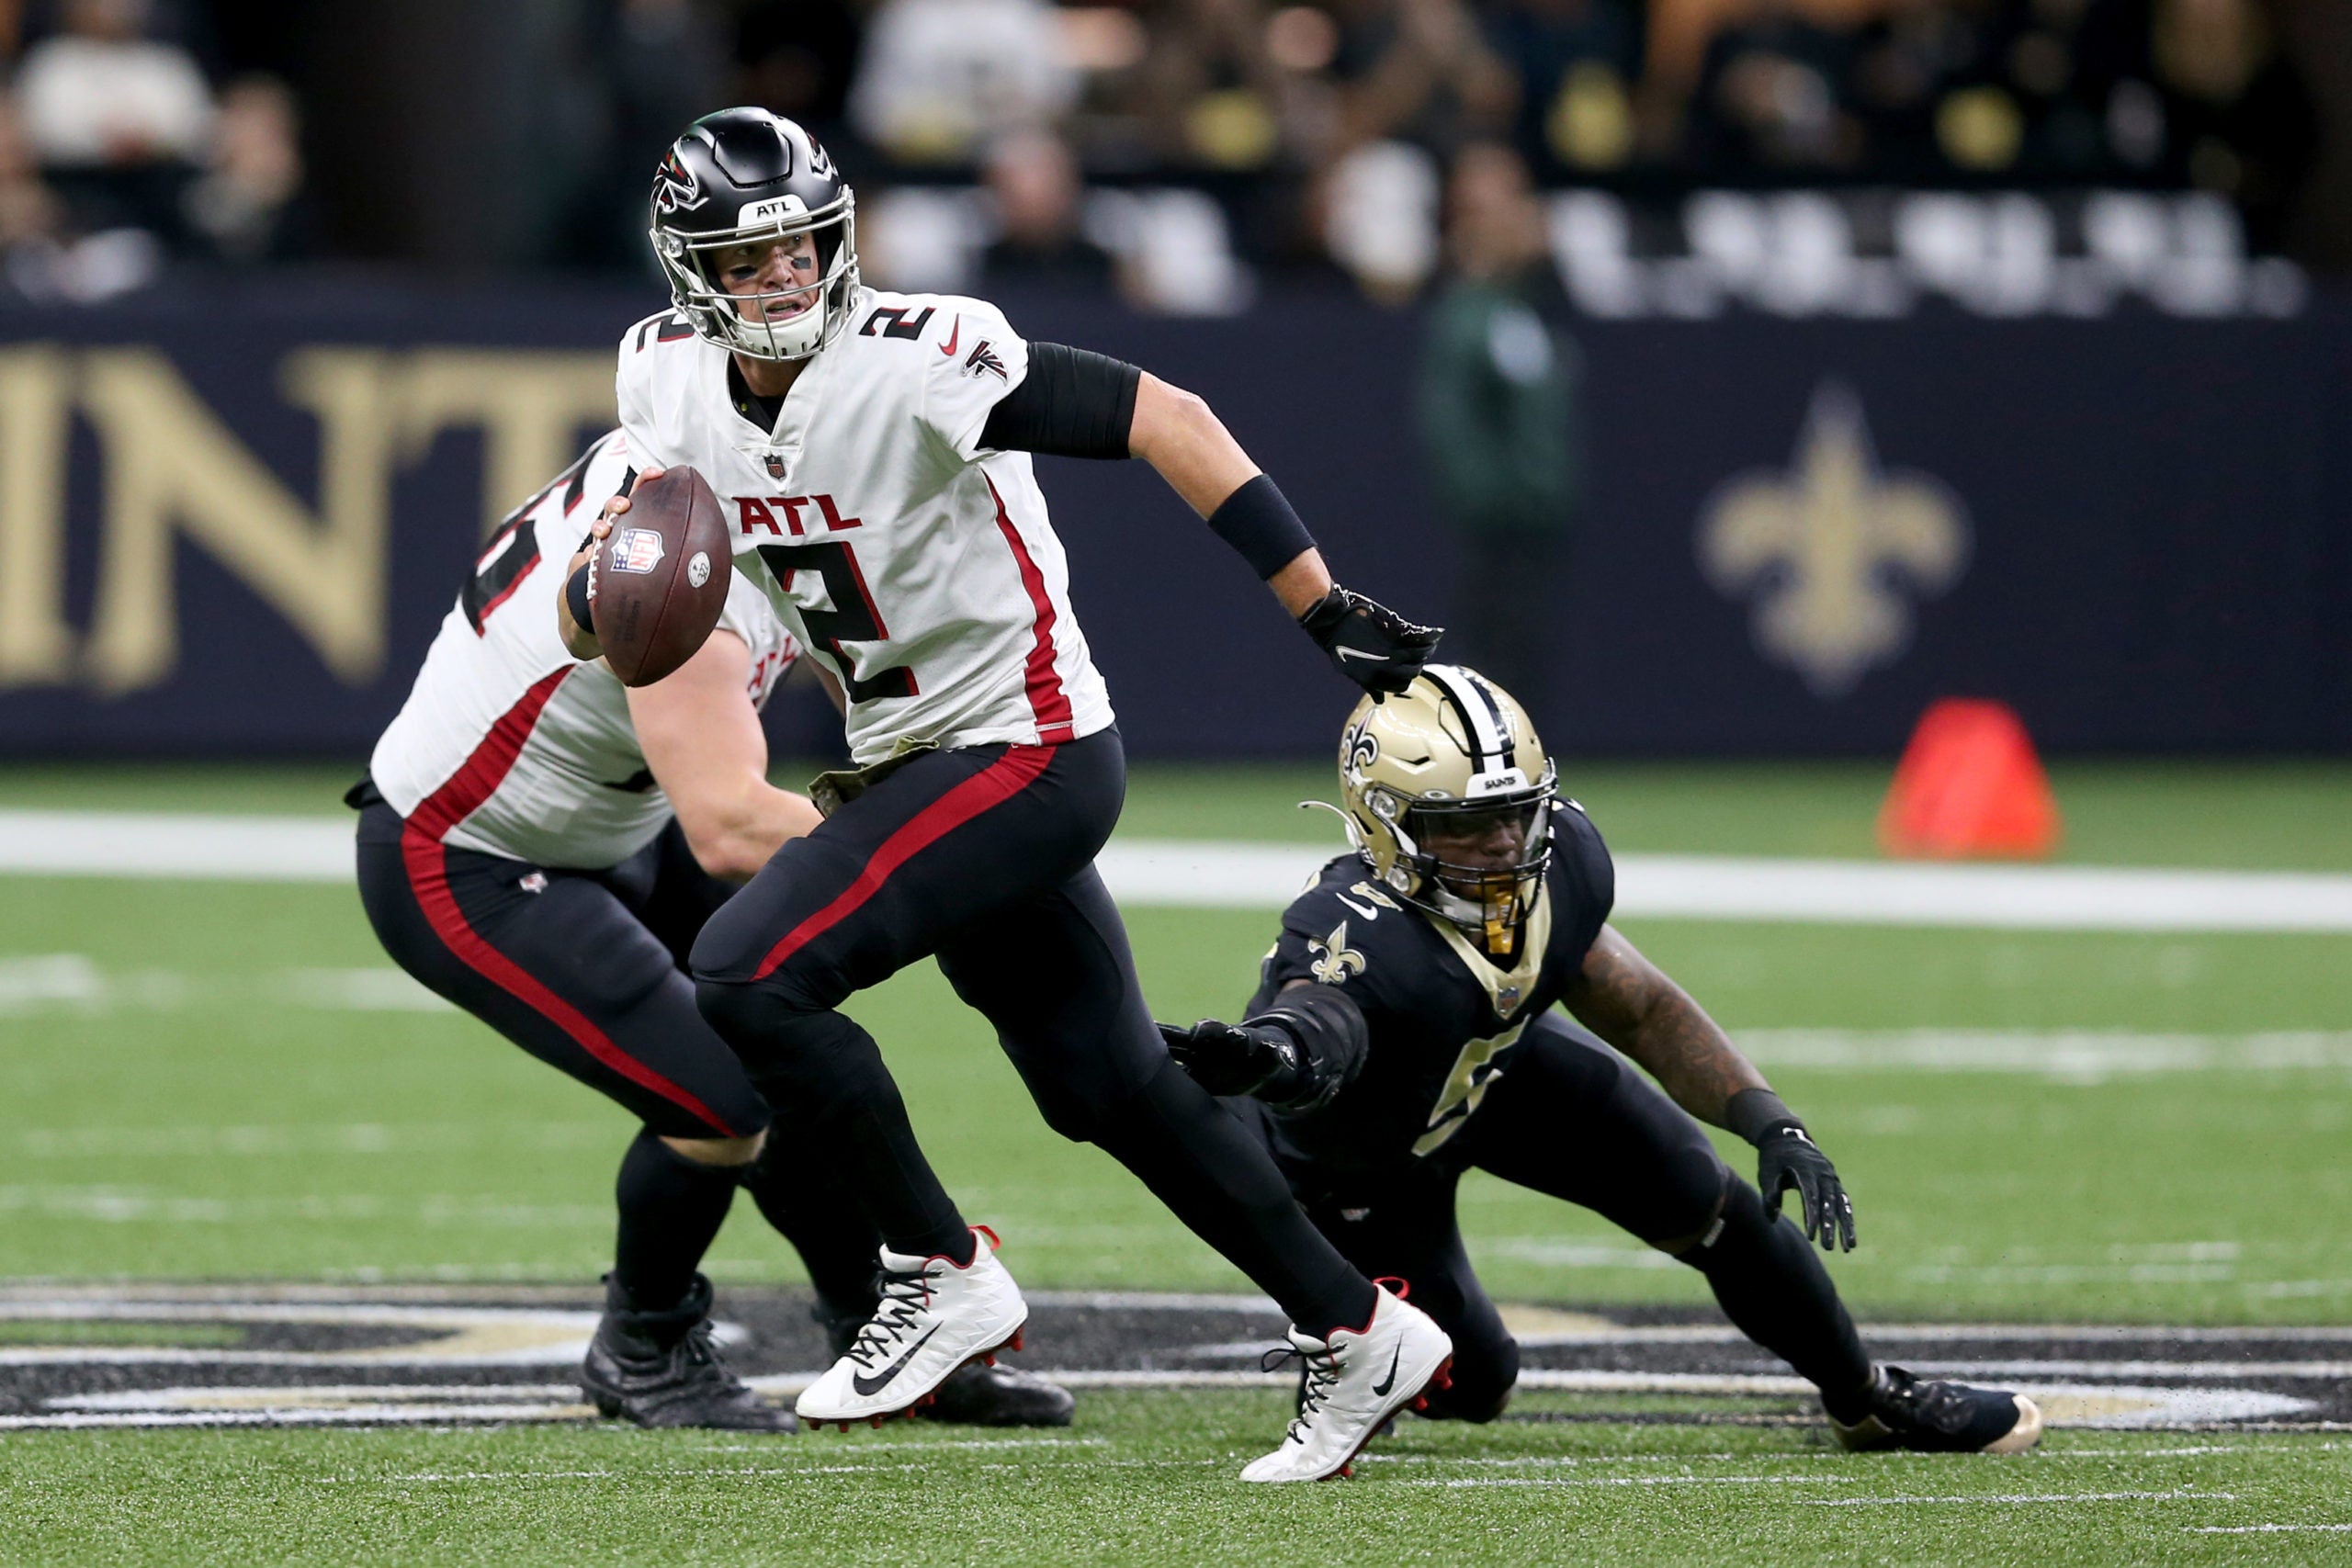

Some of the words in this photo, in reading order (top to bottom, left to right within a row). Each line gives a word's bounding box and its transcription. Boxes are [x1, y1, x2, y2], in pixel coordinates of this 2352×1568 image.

[757, 201, 791, 217] ATL
[859, 306, 935, 341] 2
[731, 494, 863, 536] ATL
[628, 536, 656, 569] NFL
[756, 540, 921, 705] 2
